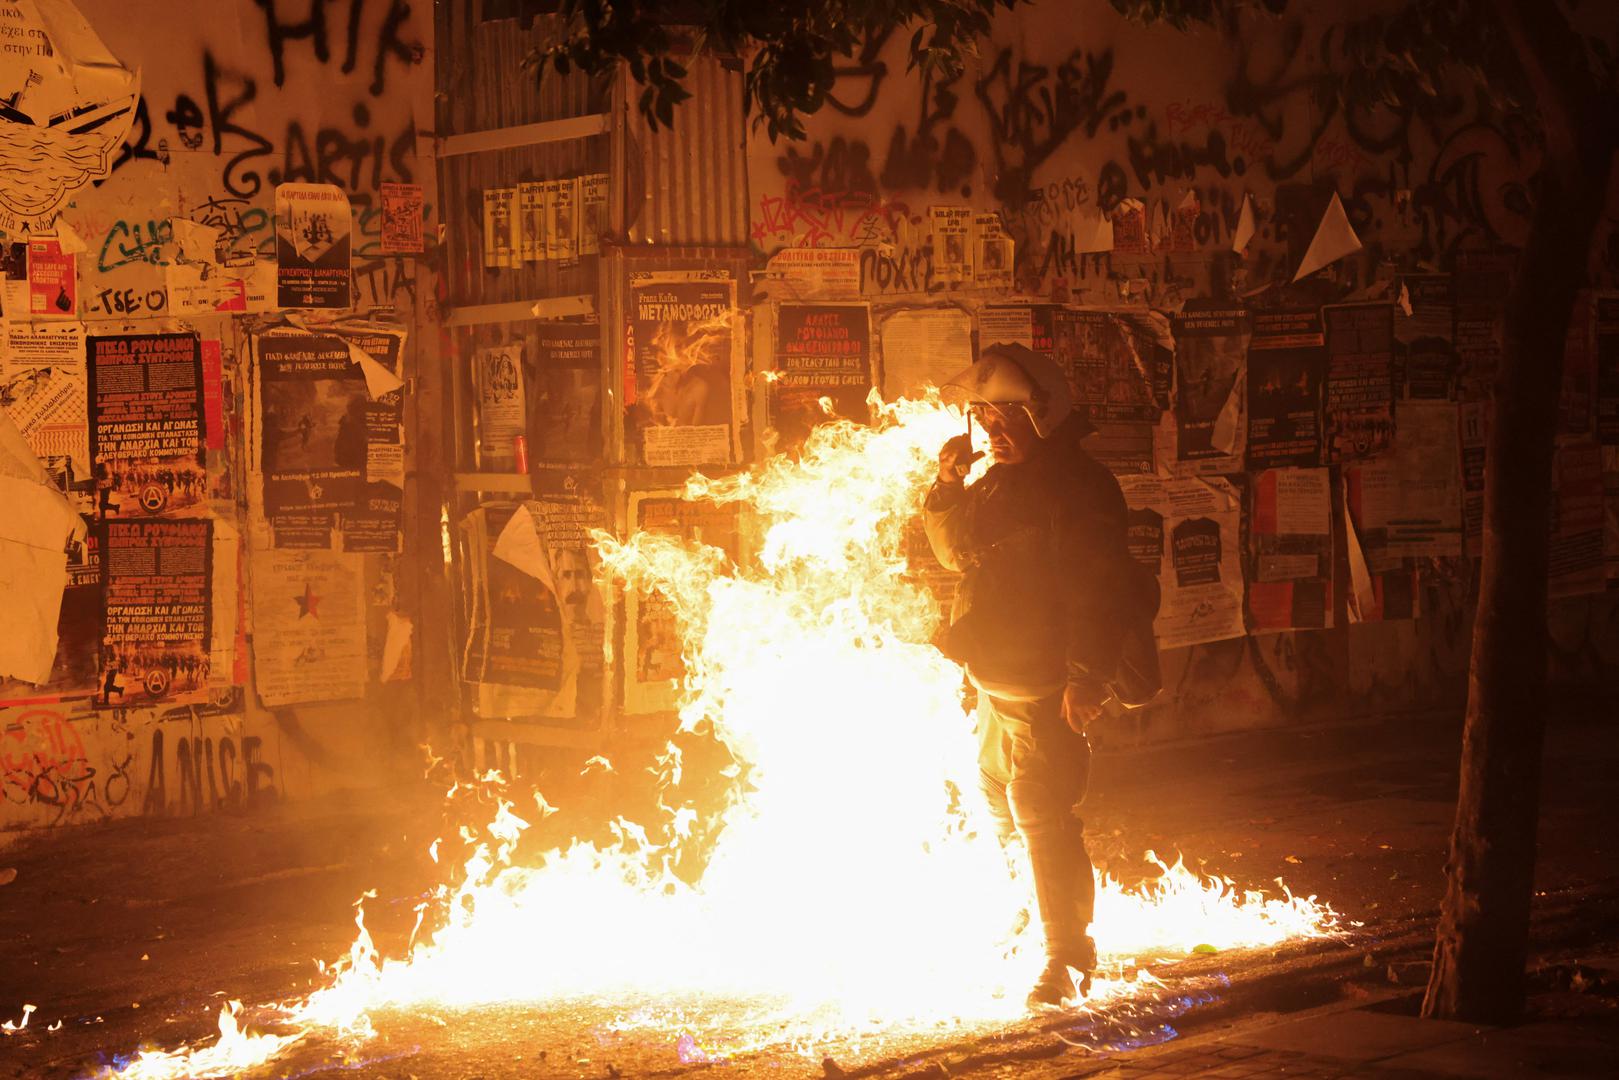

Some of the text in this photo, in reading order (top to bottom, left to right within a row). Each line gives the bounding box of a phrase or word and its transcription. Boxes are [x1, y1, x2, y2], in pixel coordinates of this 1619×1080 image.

[639, 292, 678, 302] Franz Kafka
[639, 303, 727, 321] ΜΕΤΑΜΟΡΦΩΣΗ
[96, 338, 194, 354] ΠΙΣΩ ΡΟΥΦΙΑΝΟΙ
[98, 420, 198, 434] ΟΡΓΑΝΩΣΗ ΚΑΙ ΑΓΩΝΑΣ
[109, 433, 122, 441] ΤΗΝ
[123, 432, 155, 440] ΚΟΙΝΩΝΙΚΗ
[157, 430, 198, 438] ΕΠΑΝΑΣΤΑΣΗ
[98, 437, 198, 451] ΤΗΝ ΑΝΑΡΧΙΑ ΚΑΙ ΤΟΝ
[107, 605, 205, 616] ΟΡΓΑΝΩΣΗ ΚΑΙ ΑΓΩΝΑΣ
[107, 616, 117, 624] ΓΙΑ
[118, 616, 130, 624] ΤΗΝ
[107, 623, 204, 634] ΤΗΝ ΑΝΑΡΧΙΑ ΚΑΙ ΤΟΝ
